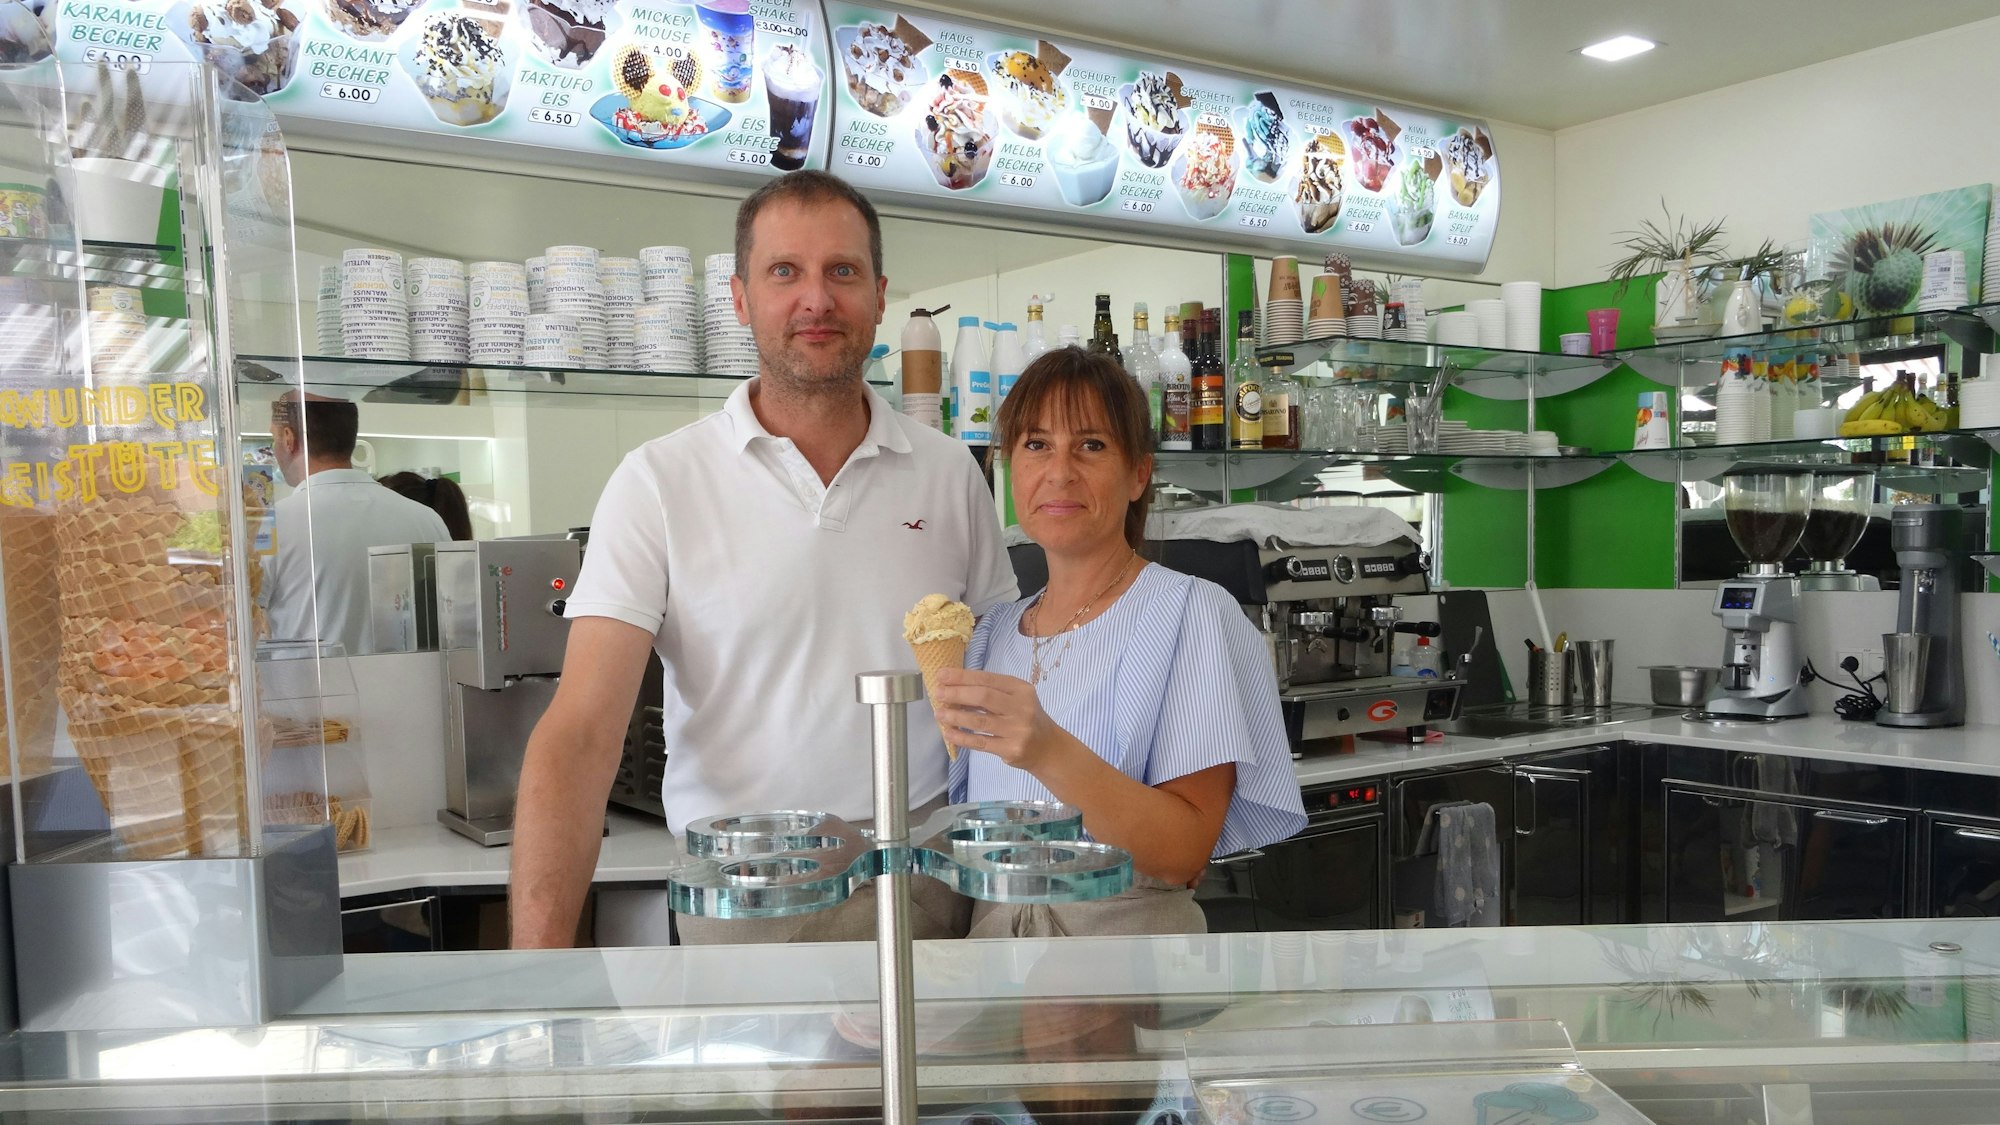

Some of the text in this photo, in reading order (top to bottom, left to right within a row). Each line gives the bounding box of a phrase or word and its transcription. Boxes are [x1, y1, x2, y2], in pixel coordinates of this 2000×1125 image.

[63, 1, 167, 31] KARAMEL
[632, 8, 692, 28] MICKEY
[749, 5, 796, 22] SHAKE
[71, 24, 162, 52] BECHER
[634, 24, 692, 44] MOUSE
[939, 31, 974, 45] HAUS
[304, 40, 397, 66] KROKANT
[653, 45, 682, 59] 4.00
[935, 43, 984, 60] BECHER
[955, 59, 978, 72] 6.50
[311, 62, 388, 85] BECHER
[519, 70, 593, 92] TARTUFO
[1066, 67, 1118, 84] JOGHURT
[339, 87, 371, 102] 6.00
[1073, 81, 1117, 98] BECHER
[1180, 86, 1236, 105] SPAGHETTI
[541, 91, 570, 107] EIS
[1090, 97, 1111, 110] 6.00
[1190, 100, 1231, 116] BECHER
[544, 111, 572, 126] 6.50
[741, 118, 764, 131] EIS
[1206, 115, 1226, 127] 6.00
[1297, 111, 1333, 125] BECHER
[849, 119, 888, 136] NUSS
[1408, 124, 1428, 136] KIWI
[724, 130, 779, 151] KAFFEE
[841, 135, 895, 154] BECHER
[1404, 134, 1436, 148] BECHER
[1000, 143, 1042, 158] MELBA
[740, 152, 767, 165] 5.00
[857, 154, 881, 167] 6.00
[996, 158, 1044, 175] BECHER
[1011, 175, 1033, 188] 6.00
[1121, 170, 1165, 187] SCHOKO
[1119, 185, 1164, 200] BECHER
[1232, 186, 1288, 204] AFTER-EIGHT
[1132, 201, 1152, 213] 6.00
[1238, 200, 1278, 216] BECHER
[1346, 194, 1386, 210] HIMBEER
[1345, 207, 1382, 222] BECHER
[1448, 209, 1480, 223] BANANA
[1249, 217, 1268, 229] 6.50
[1450, 221, 1473, 234] SPLIT
[353, 289, 387, 297] WALNUSS
